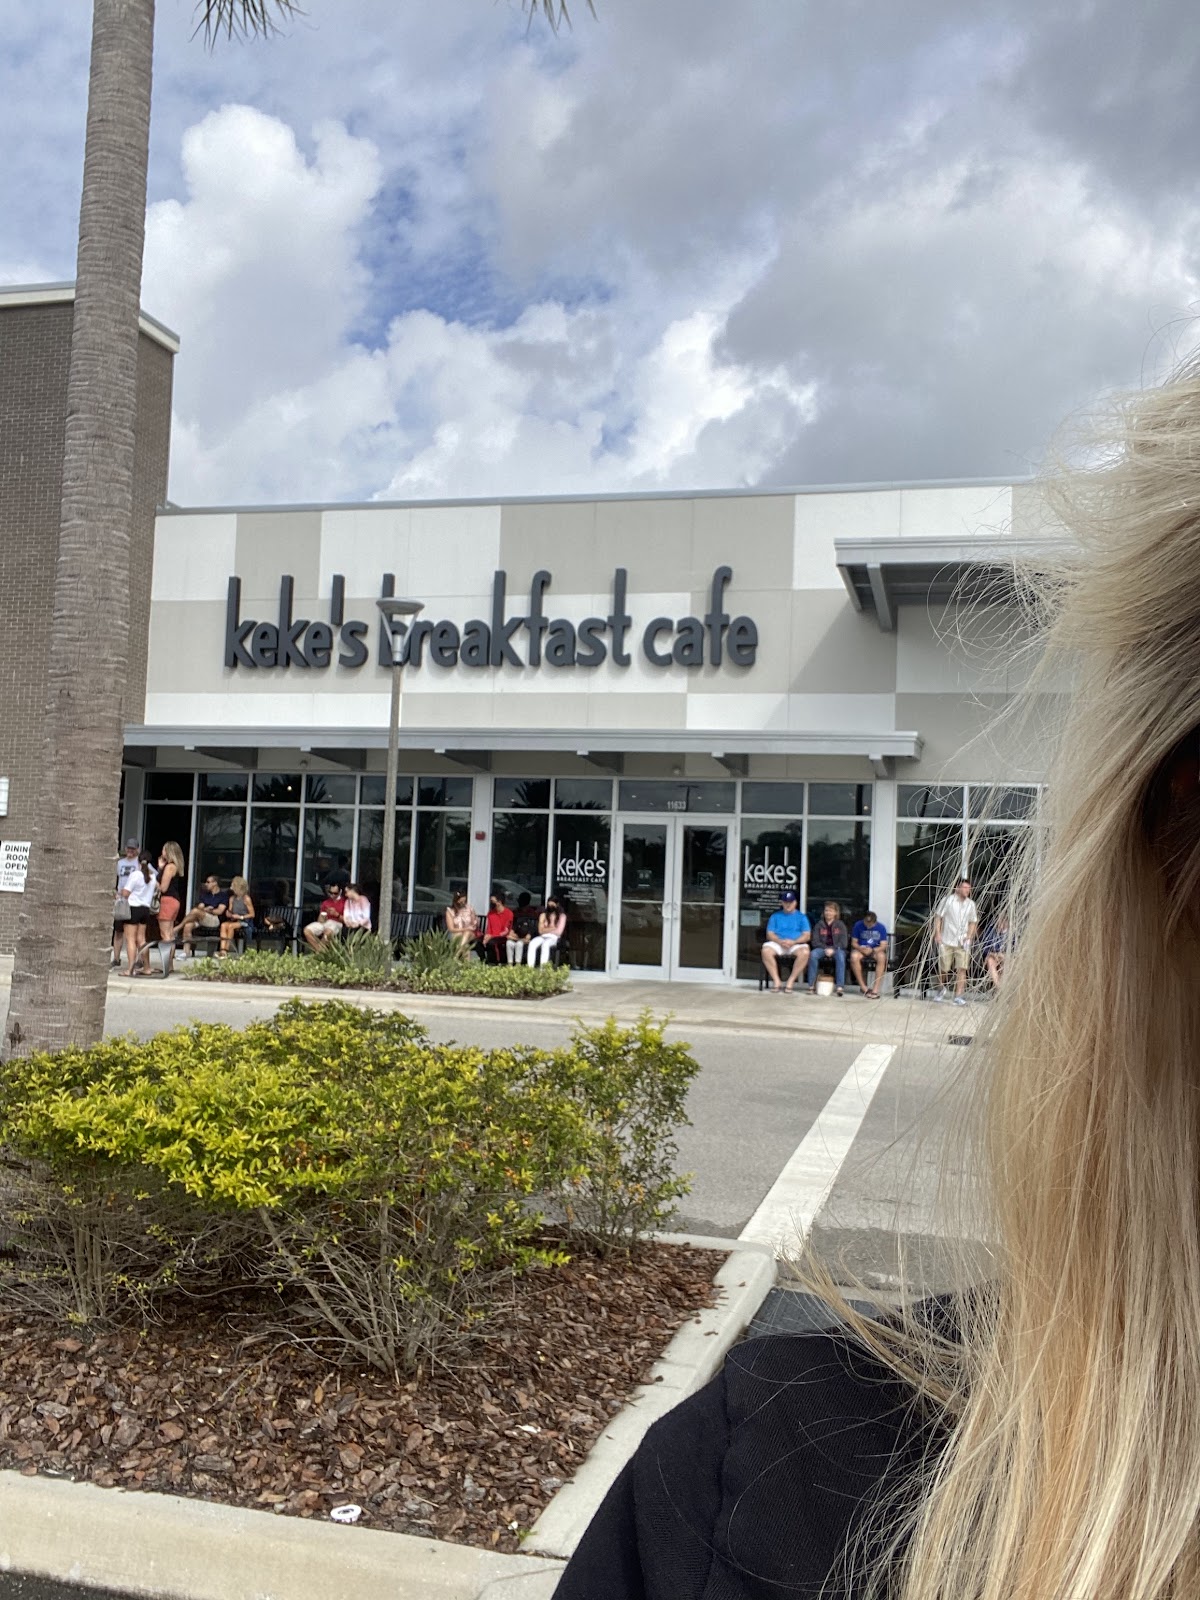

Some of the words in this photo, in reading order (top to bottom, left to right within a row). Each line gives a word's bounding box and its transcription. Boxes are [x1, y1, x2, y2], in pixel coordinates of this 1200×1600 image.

[224, 574, 369, 668] keke's
[378, 568, 632, 668] breakfast
[643, 565, 758, 667] cafe
[5, 844, 29, 853] DININ
[5, 862, 28, 870] OPEN
[556, 840, 606, 877] keke's
[744, 845, 798, 884] keke's
